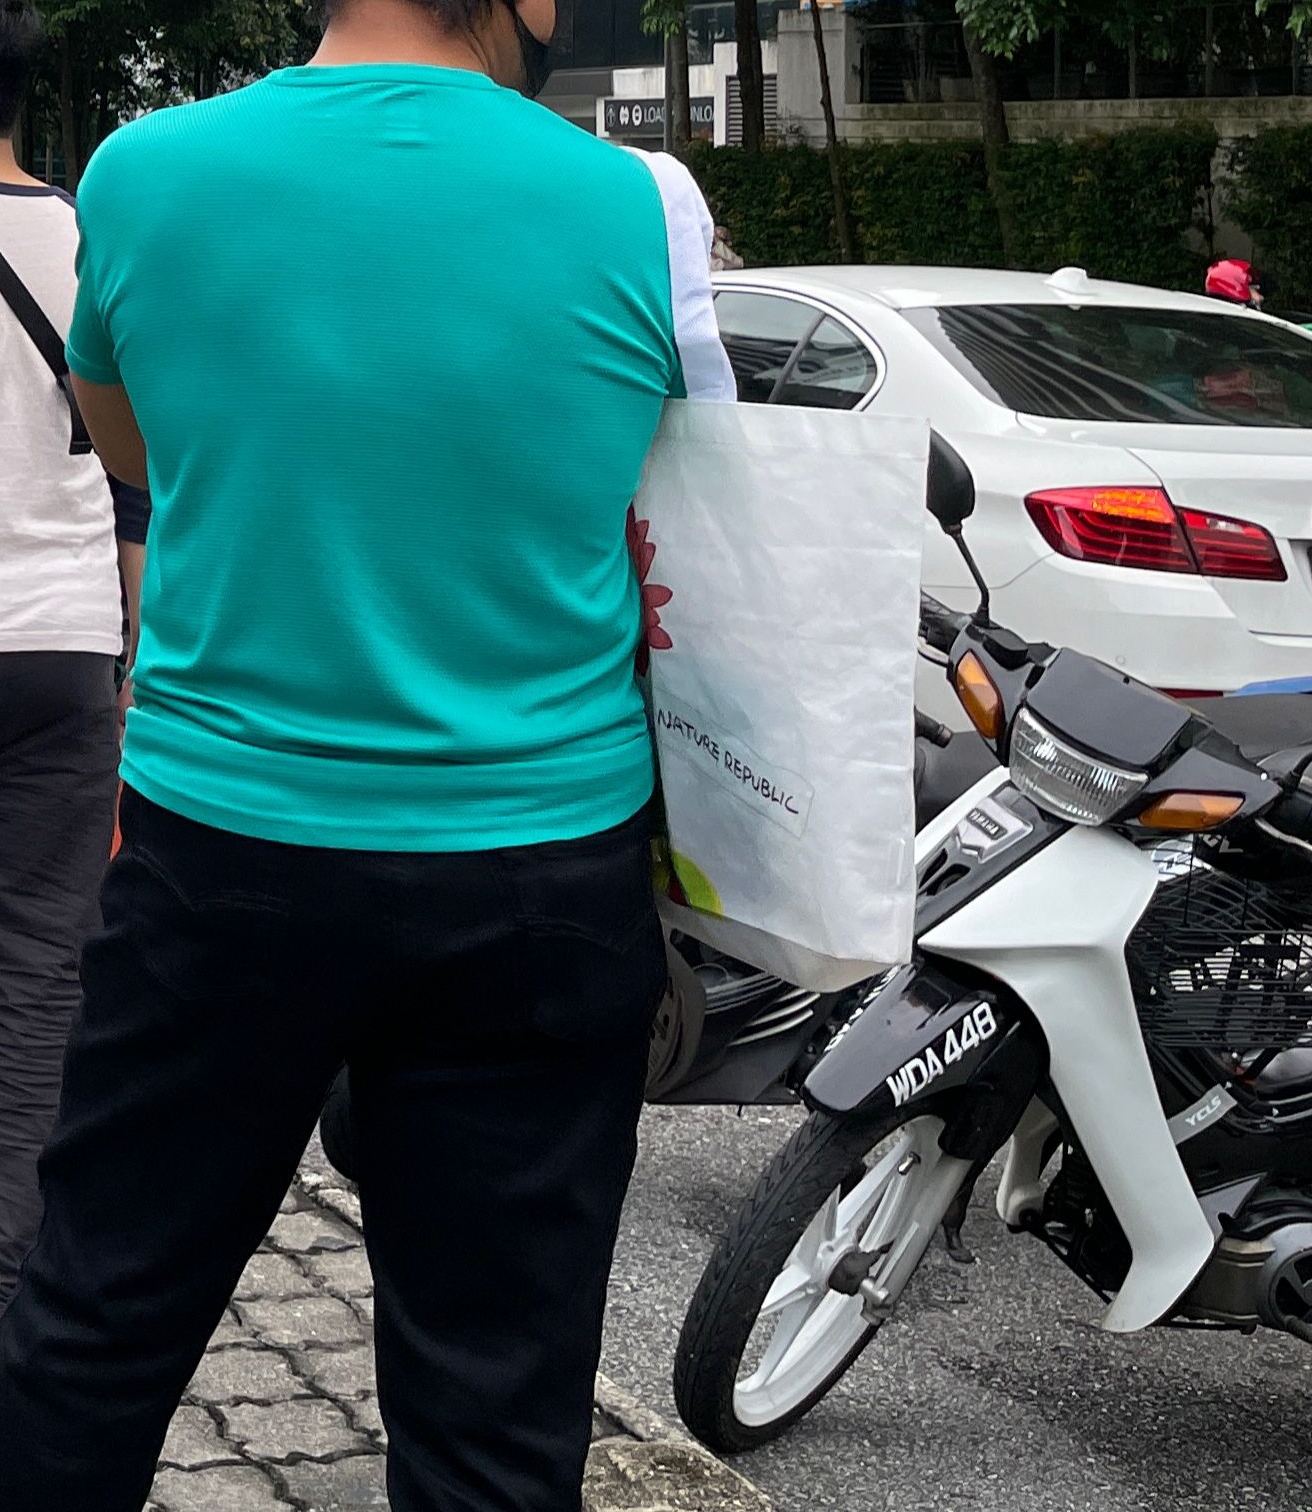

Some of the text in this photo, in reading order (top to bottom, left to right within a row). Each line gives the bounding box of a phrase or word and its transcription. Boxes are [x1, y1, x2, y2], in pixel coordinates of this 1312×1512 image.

[657, 709, 799, 814] NATURE REPUBLIC
[886, 1046, 944, 1108] WDA
[943, 1001, 997, 1065] 448
